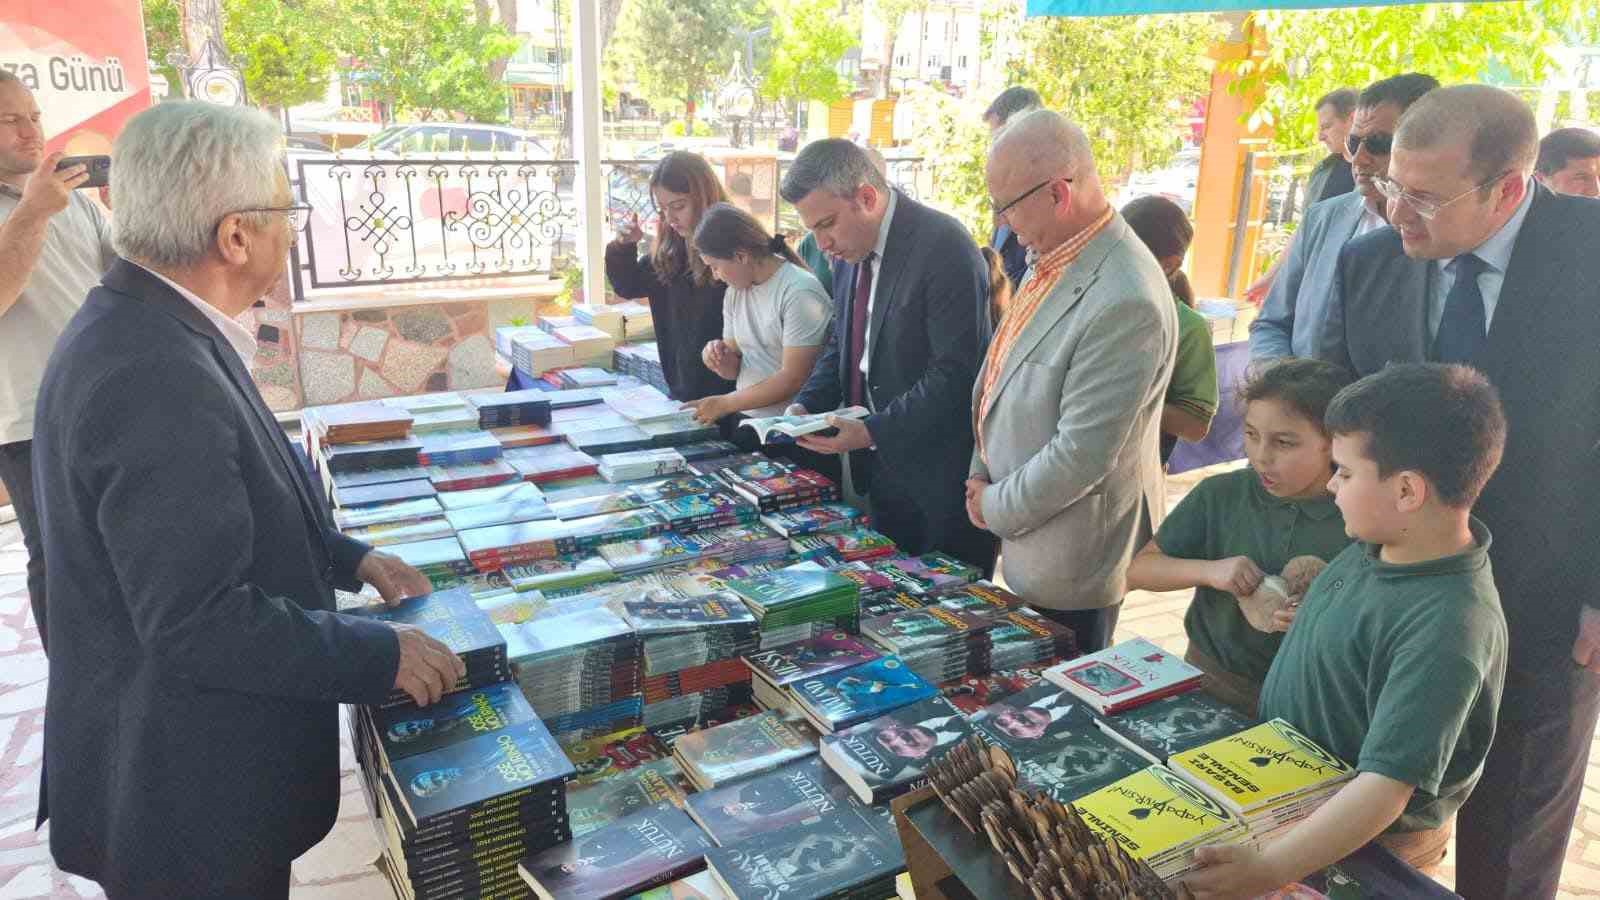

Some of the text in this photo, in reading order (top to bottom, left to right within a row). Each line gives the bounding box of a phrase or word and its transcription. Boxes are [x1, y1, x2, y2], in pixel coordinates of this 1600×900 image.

[49, 56, 124, 92] Günü
[848, 733, 890, 775] NUTUK
[788, 769, 835, 815] NUTUK
[637, 817, 684, 859] NUTUK
